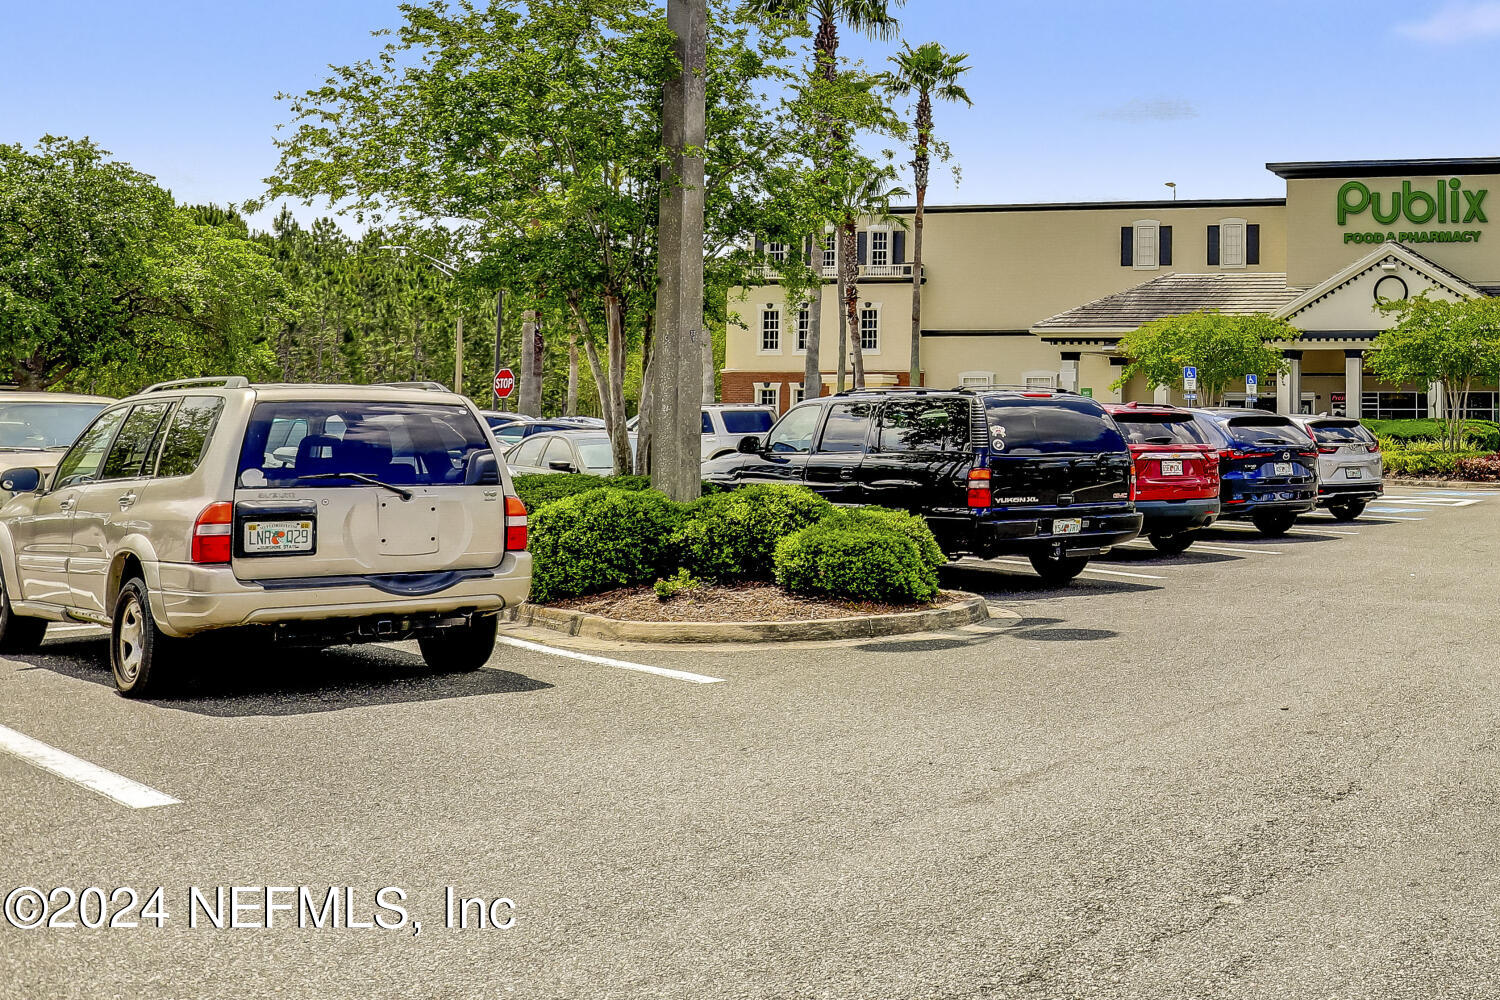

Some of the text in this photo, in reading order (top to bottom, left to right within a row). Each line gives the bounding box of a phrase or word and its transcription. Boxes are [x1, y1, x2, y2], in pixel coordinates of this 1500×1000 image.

[1337, 178, 1489, 226] Publix
[1343, 232, 1385, 245] FOOD
[1399, 230, 1482, 244] PHARMACY
[495, 377, 514, 390] STOP
[994, 496, 1026, 504] YUKON
[249, 531, 271, 545] LNR
